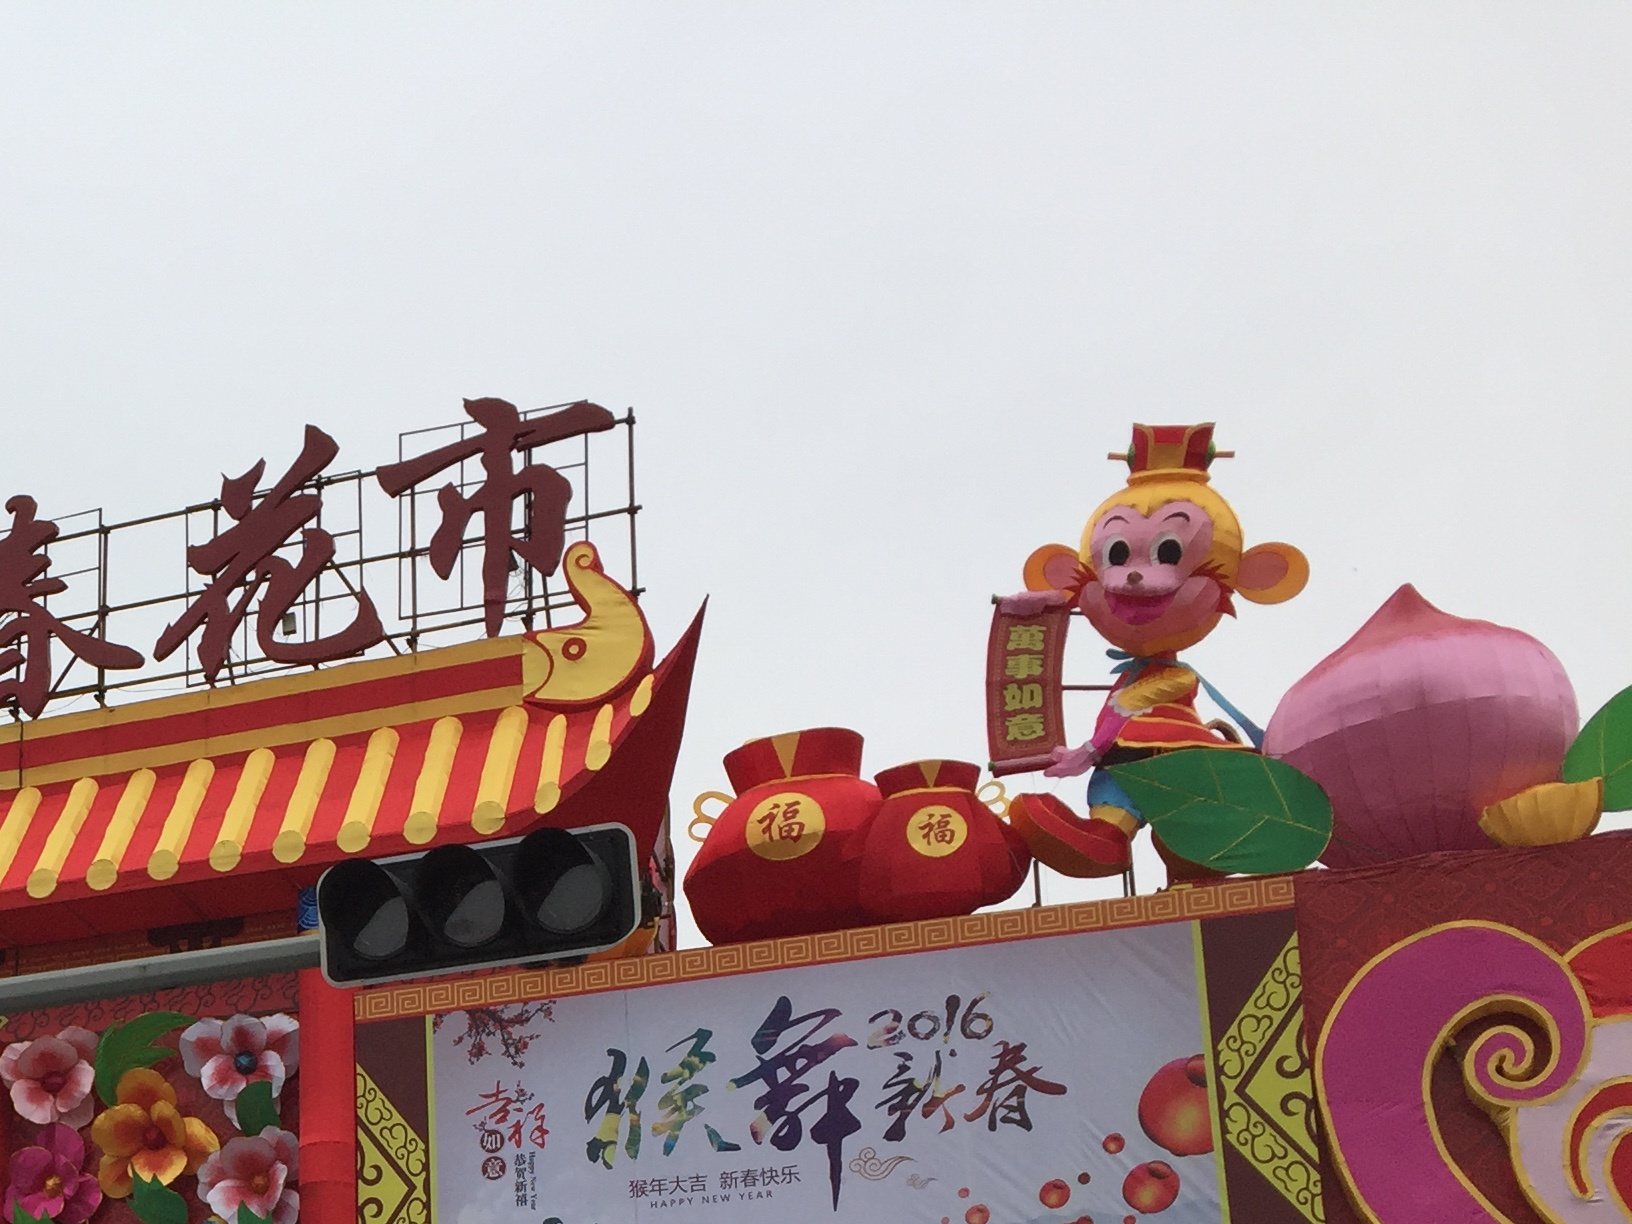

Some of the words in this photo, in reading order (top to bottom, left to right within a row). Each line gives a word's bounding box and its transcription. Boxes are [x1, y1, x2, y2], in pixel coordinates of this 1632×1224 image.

[1004, 625, 1047, 741] 萬事如意
[757, 800, 806, 844] 福
[918, 812, 956, 846] 福
[867, 991, 994, 1050] 2016
[629, 1174, 708, 1199] 猴年大吉
[719, 1165, 801, 1190] 新春快乐
[650, 1197, 694, 1210] HAPPY
[702, 1192, 731, 1205] NEW
[739, 1188, 773, 1200] YEAR
